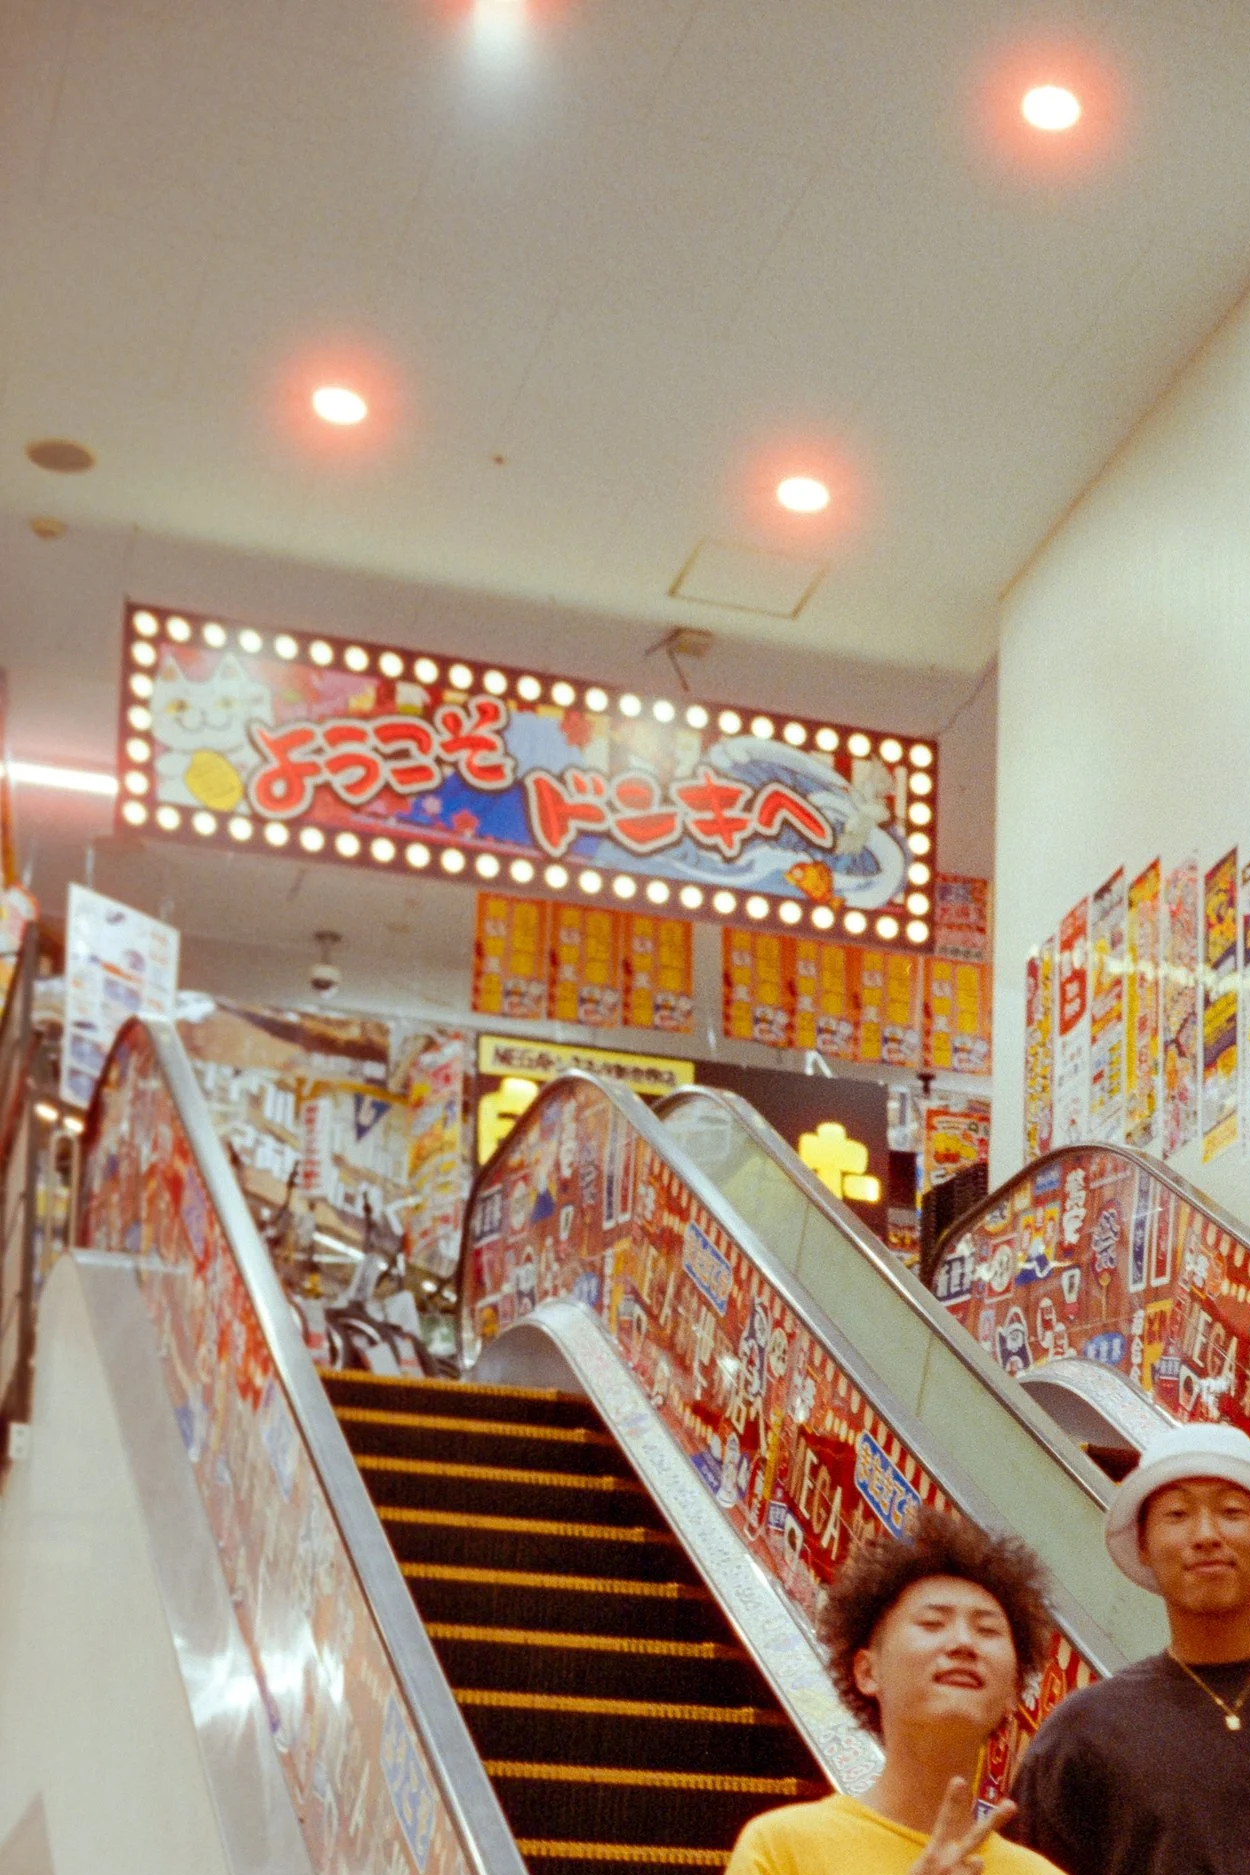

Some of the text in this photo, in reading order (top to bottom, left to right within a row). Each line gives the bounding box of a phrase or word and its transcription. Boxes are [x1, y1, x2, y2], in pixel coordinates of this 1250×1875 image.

[249, 694, 516, 820] ようこそ
[526, 767, 834, 855] ドンキへ
